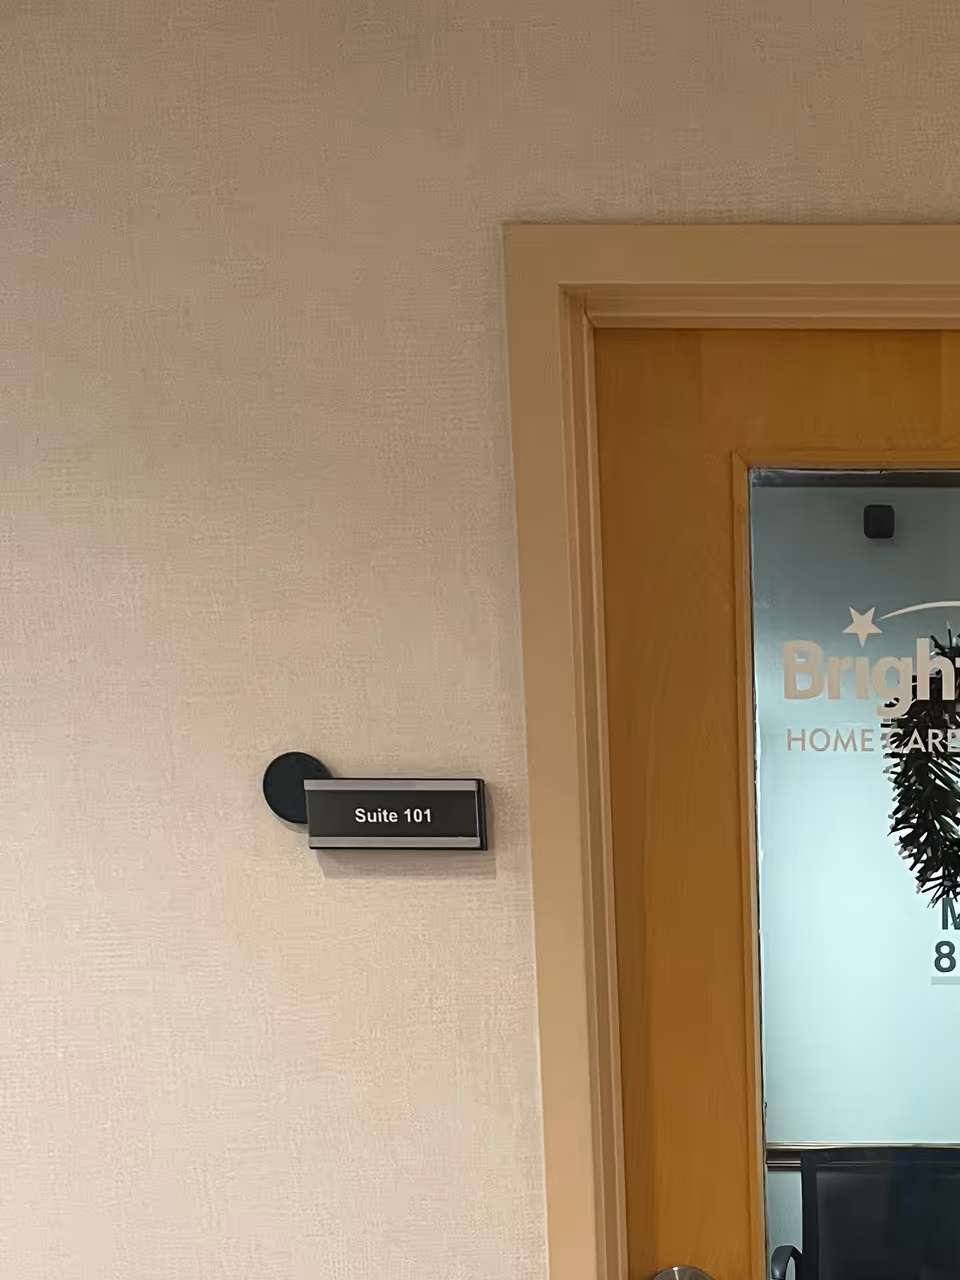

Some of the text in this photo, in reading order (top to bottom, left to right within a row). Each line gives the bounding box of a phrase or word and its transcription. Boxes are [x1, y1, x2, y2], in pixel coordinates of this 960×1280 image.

[786, 728, 875, 752] HOME
[354, 808, 432, 823] Suite 101
